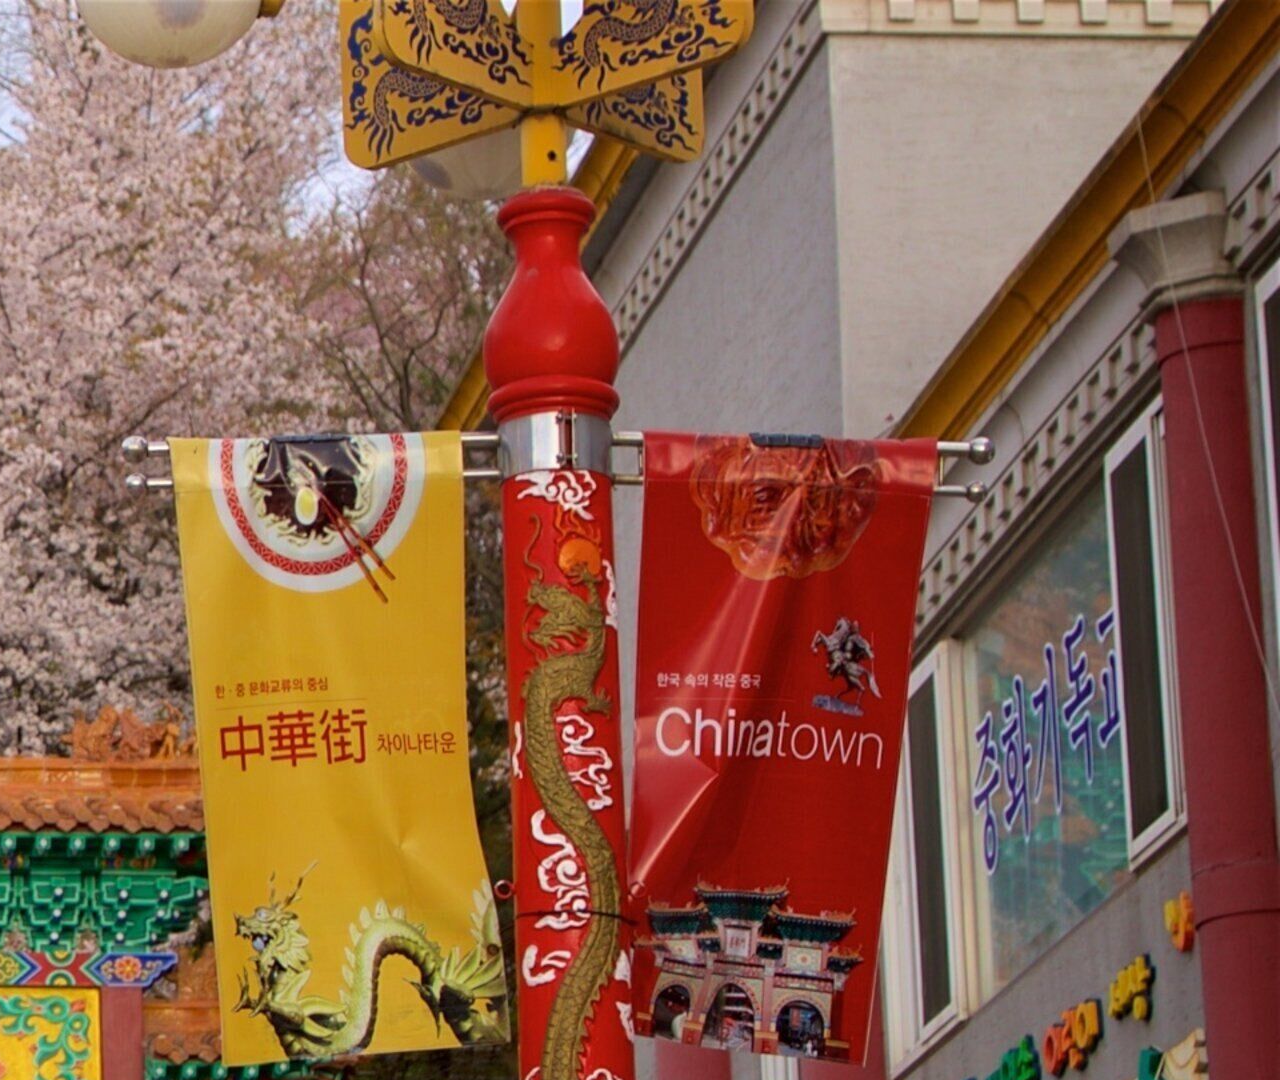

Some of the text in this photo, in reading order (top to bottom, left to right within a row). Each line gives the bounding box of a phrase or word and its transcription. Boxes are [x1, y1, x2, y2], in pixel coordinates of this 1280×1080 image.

[249, 677, 304, 696] 문화교류의
[307, 677, 328, 691] 중심
[657, 672, 761, 688] 한국 속의 작은 중국
[220, 708, 457, 772] 中華街 차이나타운
[656, 706, 883, 770] Chinatown
[1044, 1000, 1102, 1076] 어린이
